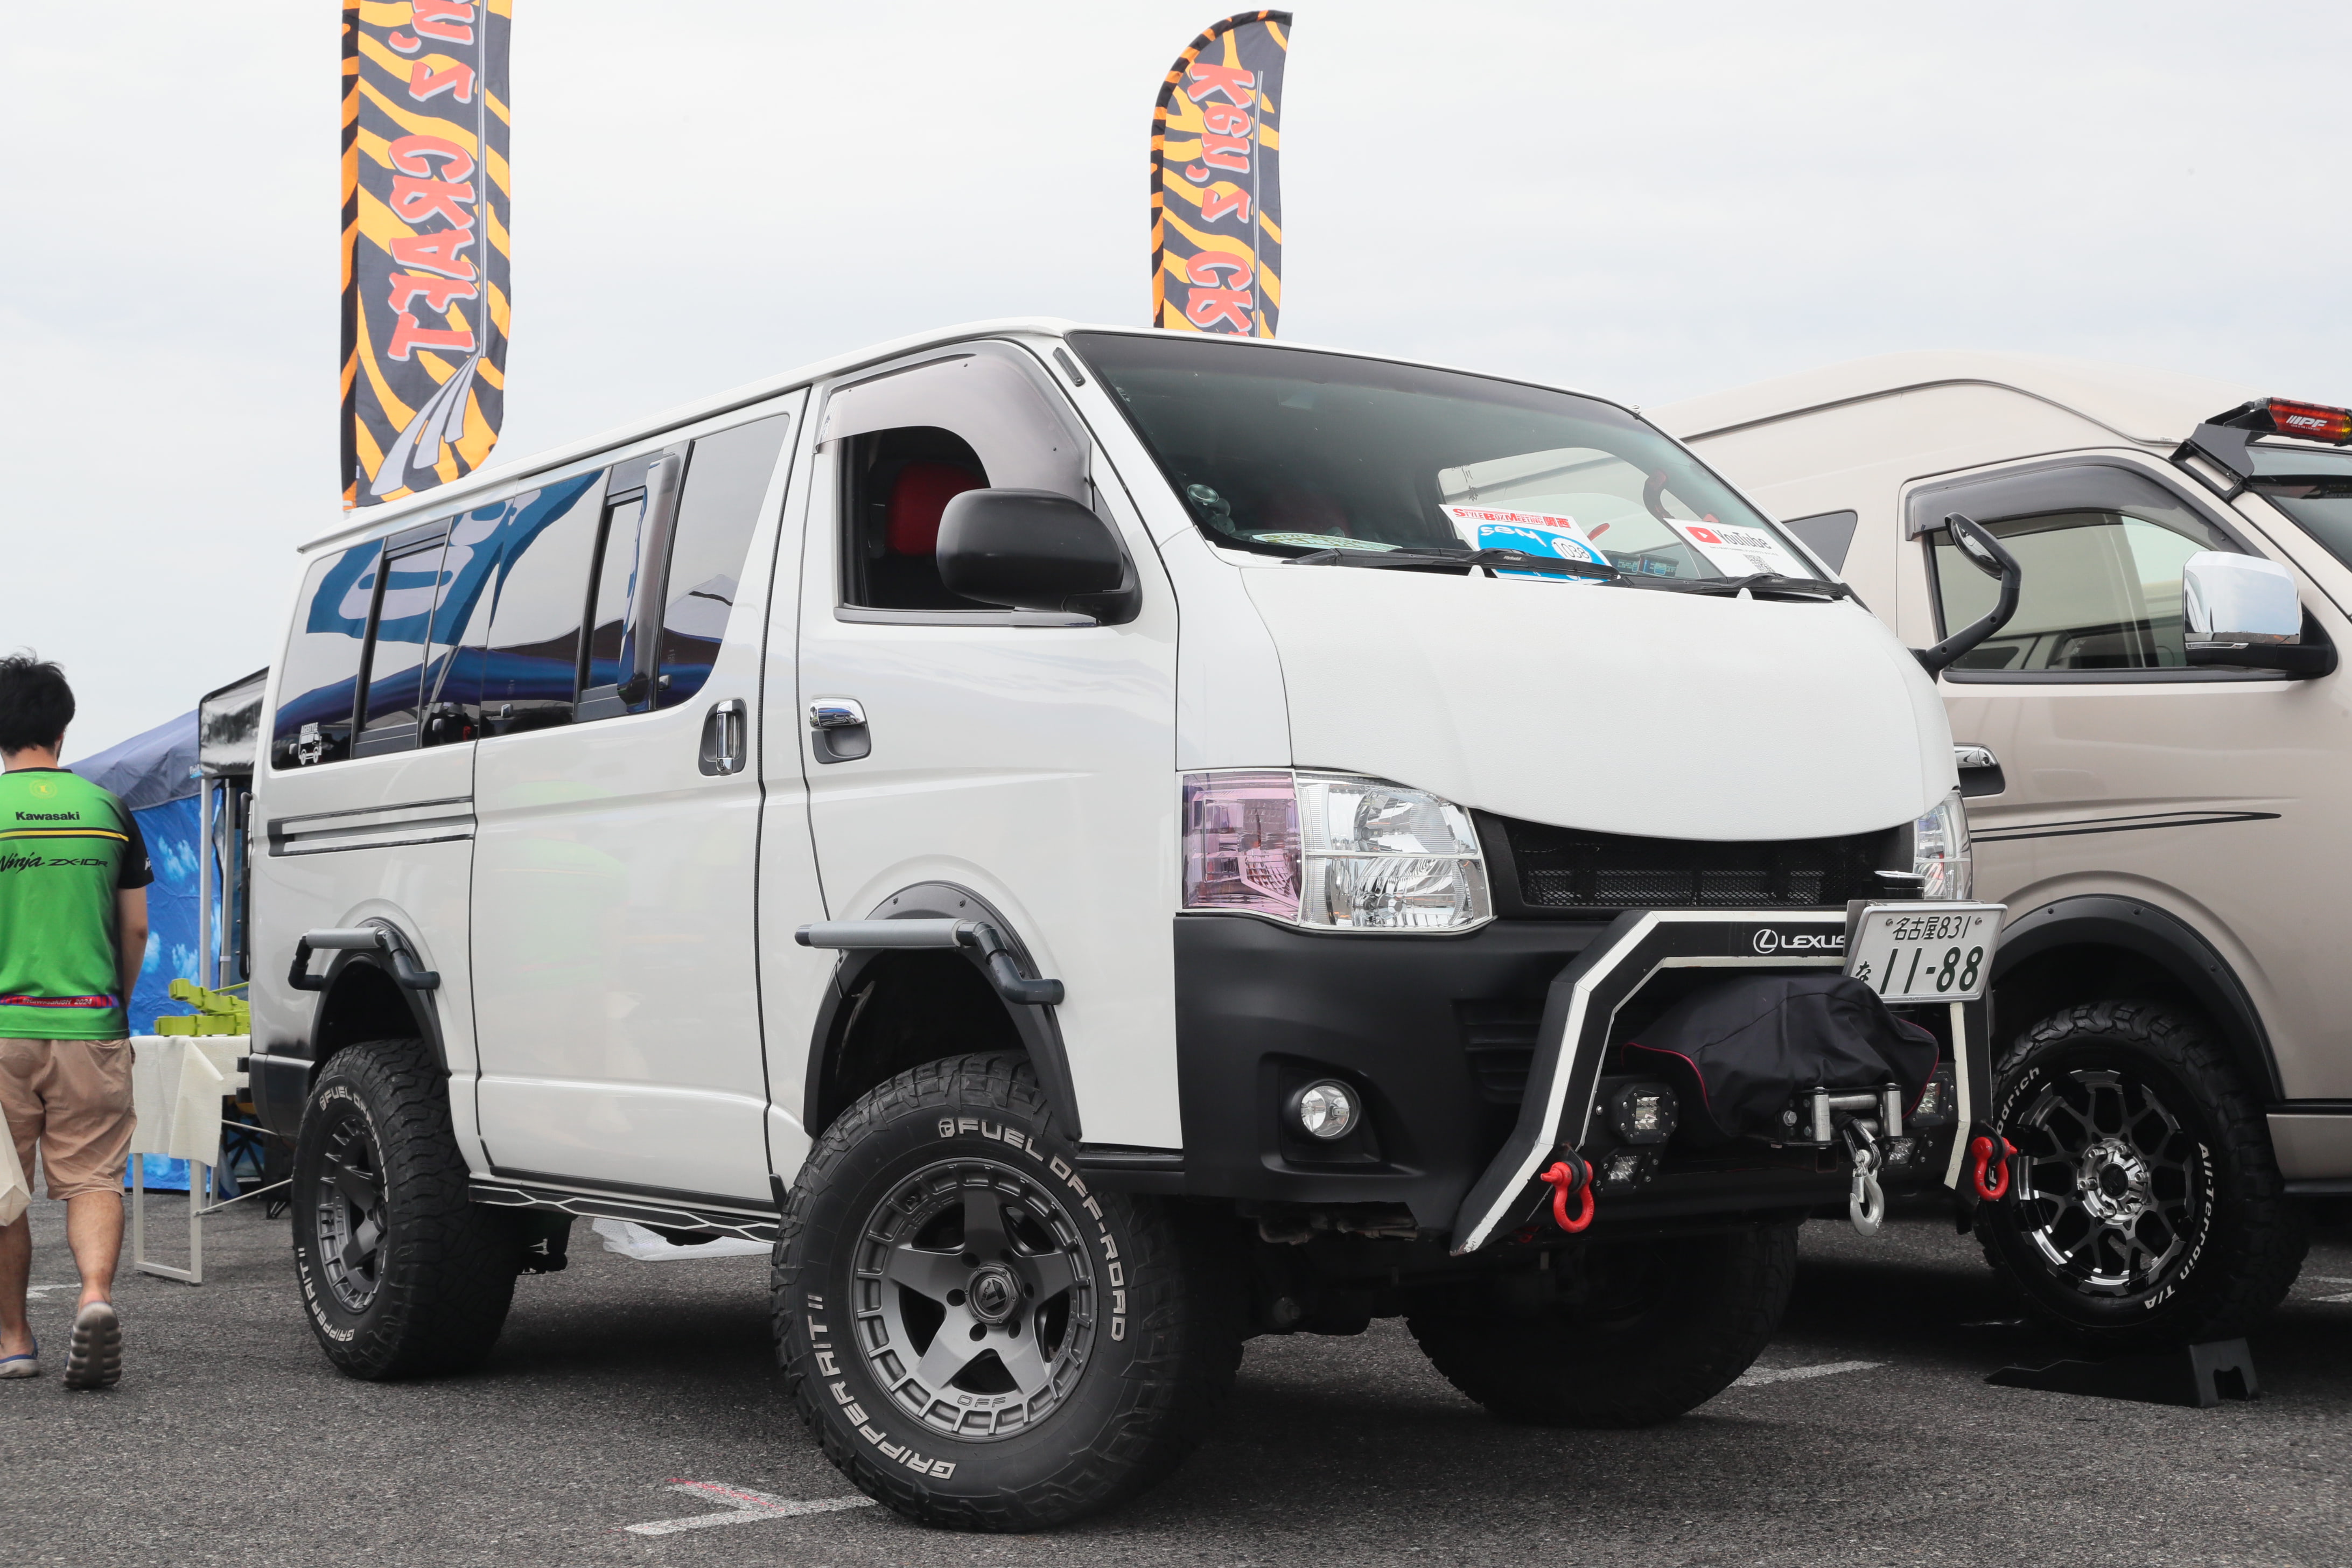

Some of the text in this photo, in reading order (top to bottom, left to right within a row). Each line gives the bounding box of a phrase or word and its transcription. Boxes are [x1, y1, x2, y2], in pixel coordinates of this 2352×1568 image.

[1553, 541, 1590, 559] 1038
[1711, 529, 1772, 549] YouTube
[16, 811, 80, 821] Kawasaki
[0, 852, 108, 874] Ninja ZX-10R
[1879, 945, 1984, 995] 11-88
[324, 1086, 353, 1103] FUEL
[958, 1119, 1128, 1342] FUEL OFF-ROAD
[2144, 1142, 2214, 1310] All-Terrain T/A
[311, 1299, 355, 1341] GRIPPER
[957, 1395, 1006, 1408] OFF
[829, 1382, 956, 1480] GRIPPER
